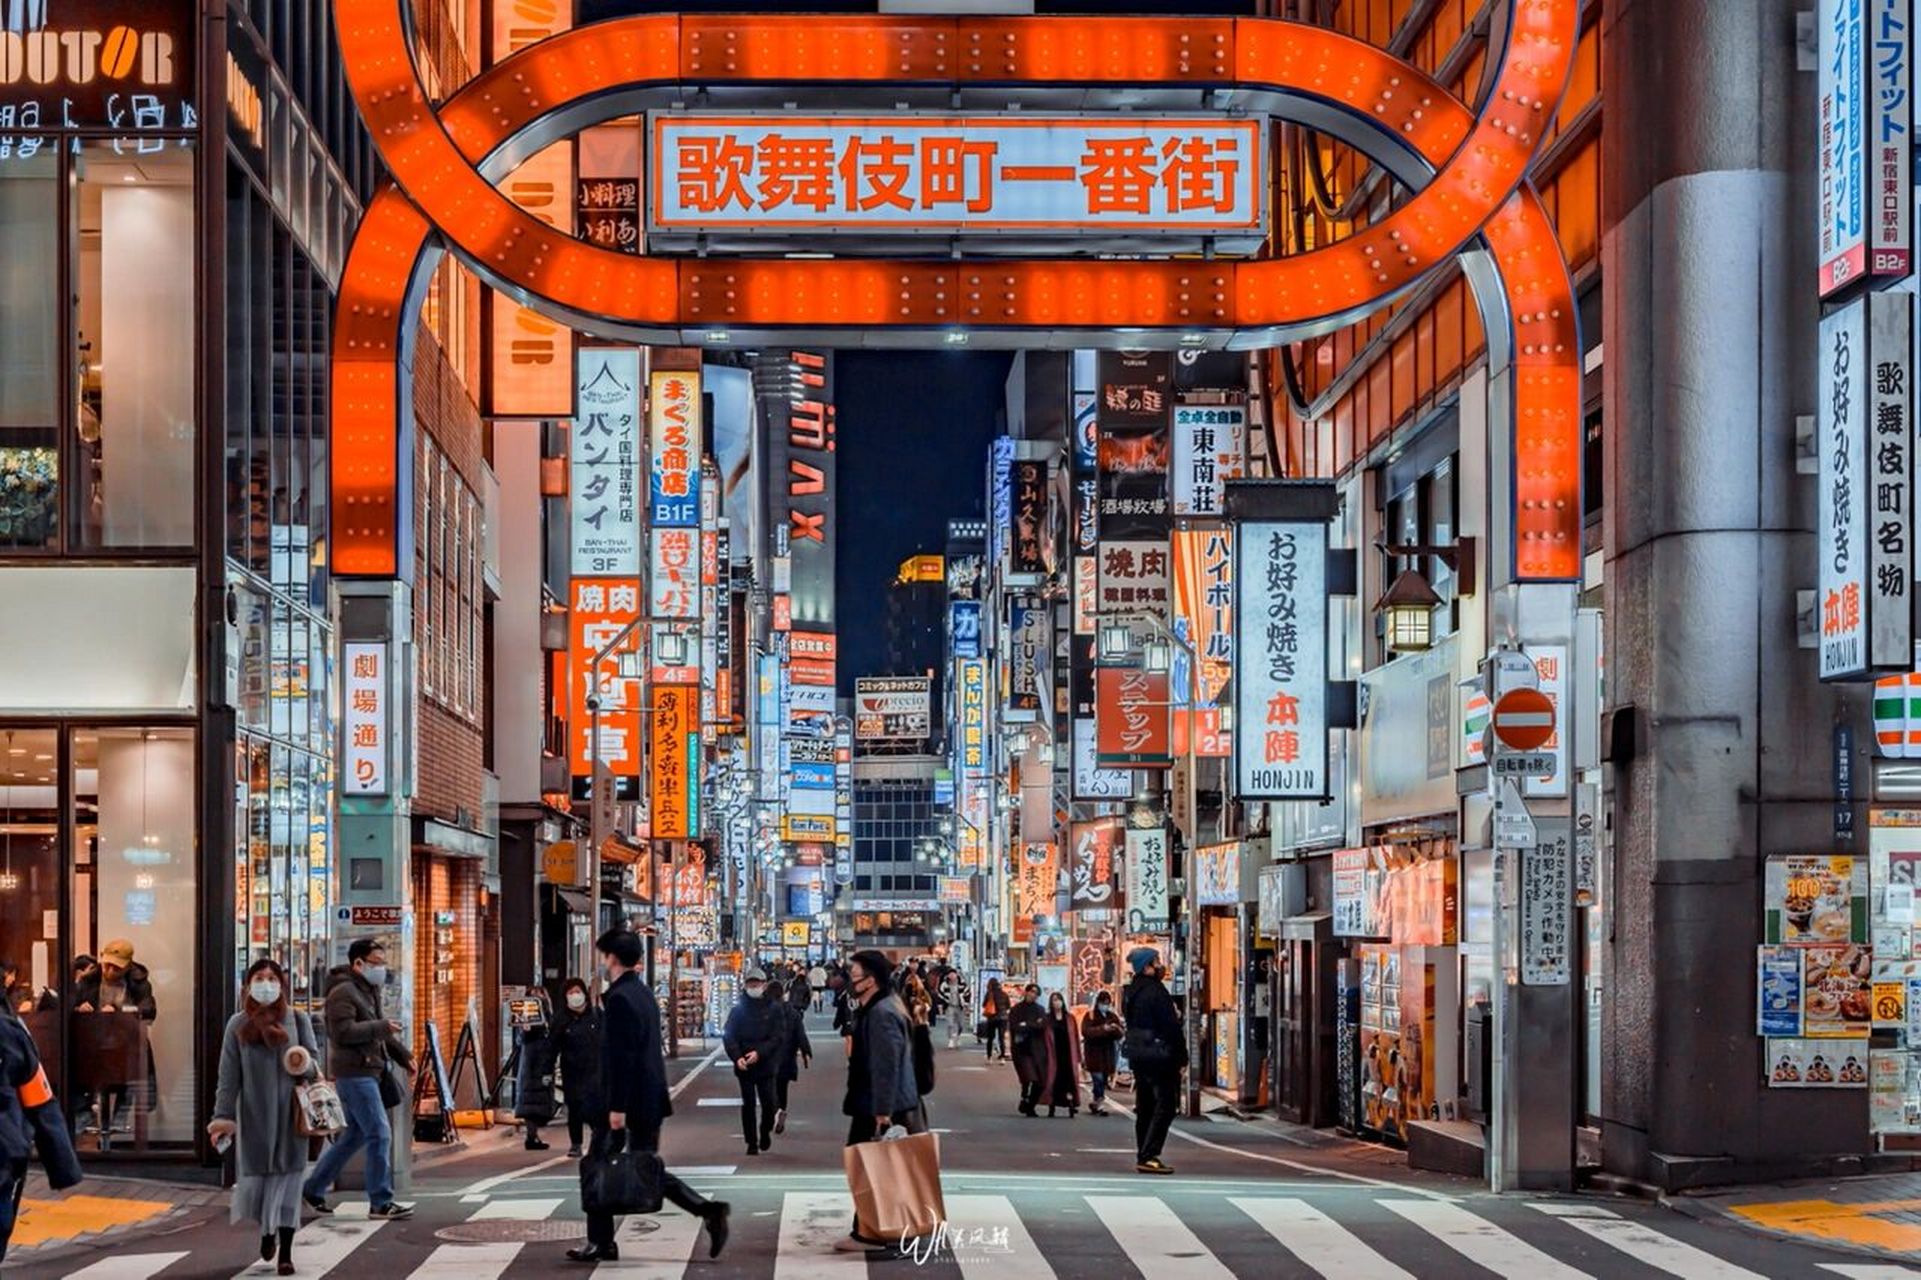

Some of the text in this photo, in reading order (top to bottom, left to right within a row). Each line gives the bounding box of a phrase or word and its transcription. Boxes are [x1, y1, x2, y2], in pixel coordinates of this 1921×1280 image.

[0, 25, 173, 84] OUTOR
[1876, 0, 1906, 143] トフィット
[676, 134, 1239, 215] 歌舞伎町一番街
[1882, 147, 1898, 243] 新宿東口駅前
[1875, 254, 1906, 270] B2F
[660, 378, 690, 496] まぐろ商店
[1177, 410, 1243, 425] 全卓全自動
[1832, 331, 1850, 575] お好み焼き
[579, 412, 614, 531] バンタイ
[618, 413, 633, 523] タイ国料理専門店
[1192, 427, 1216, 513] 東南荘
[1876, 361, 1905, 597] 歌舞伎町名物
[656, 504, 695, 521] B1F
[576, 584, 637, 613] 焼肉
[592, 558, 618, 572] 3F
[1206, 536, 1230, 658] ハイボール
[1266, 531, 1299, 683] お好み焼き
[1824, 582, 1860, 638] 本陣
[1023, 612, 1036, 693] SLUSH
[1825, 640, 1858, 672] HONJIN
[353, 653, 379, 782] 劇場通り
[1119, 670, 1152, 752] ステップ
[1264, 691, 1301, 765] 本陣
[1251, 770, 1314, 790] HONJIN
[1496, 758, 1551, 774] 自転車を除く
[1838, 812, 1851, 824] 17
[1542, 843, 1555, 960] 防犯カメラ作動中
